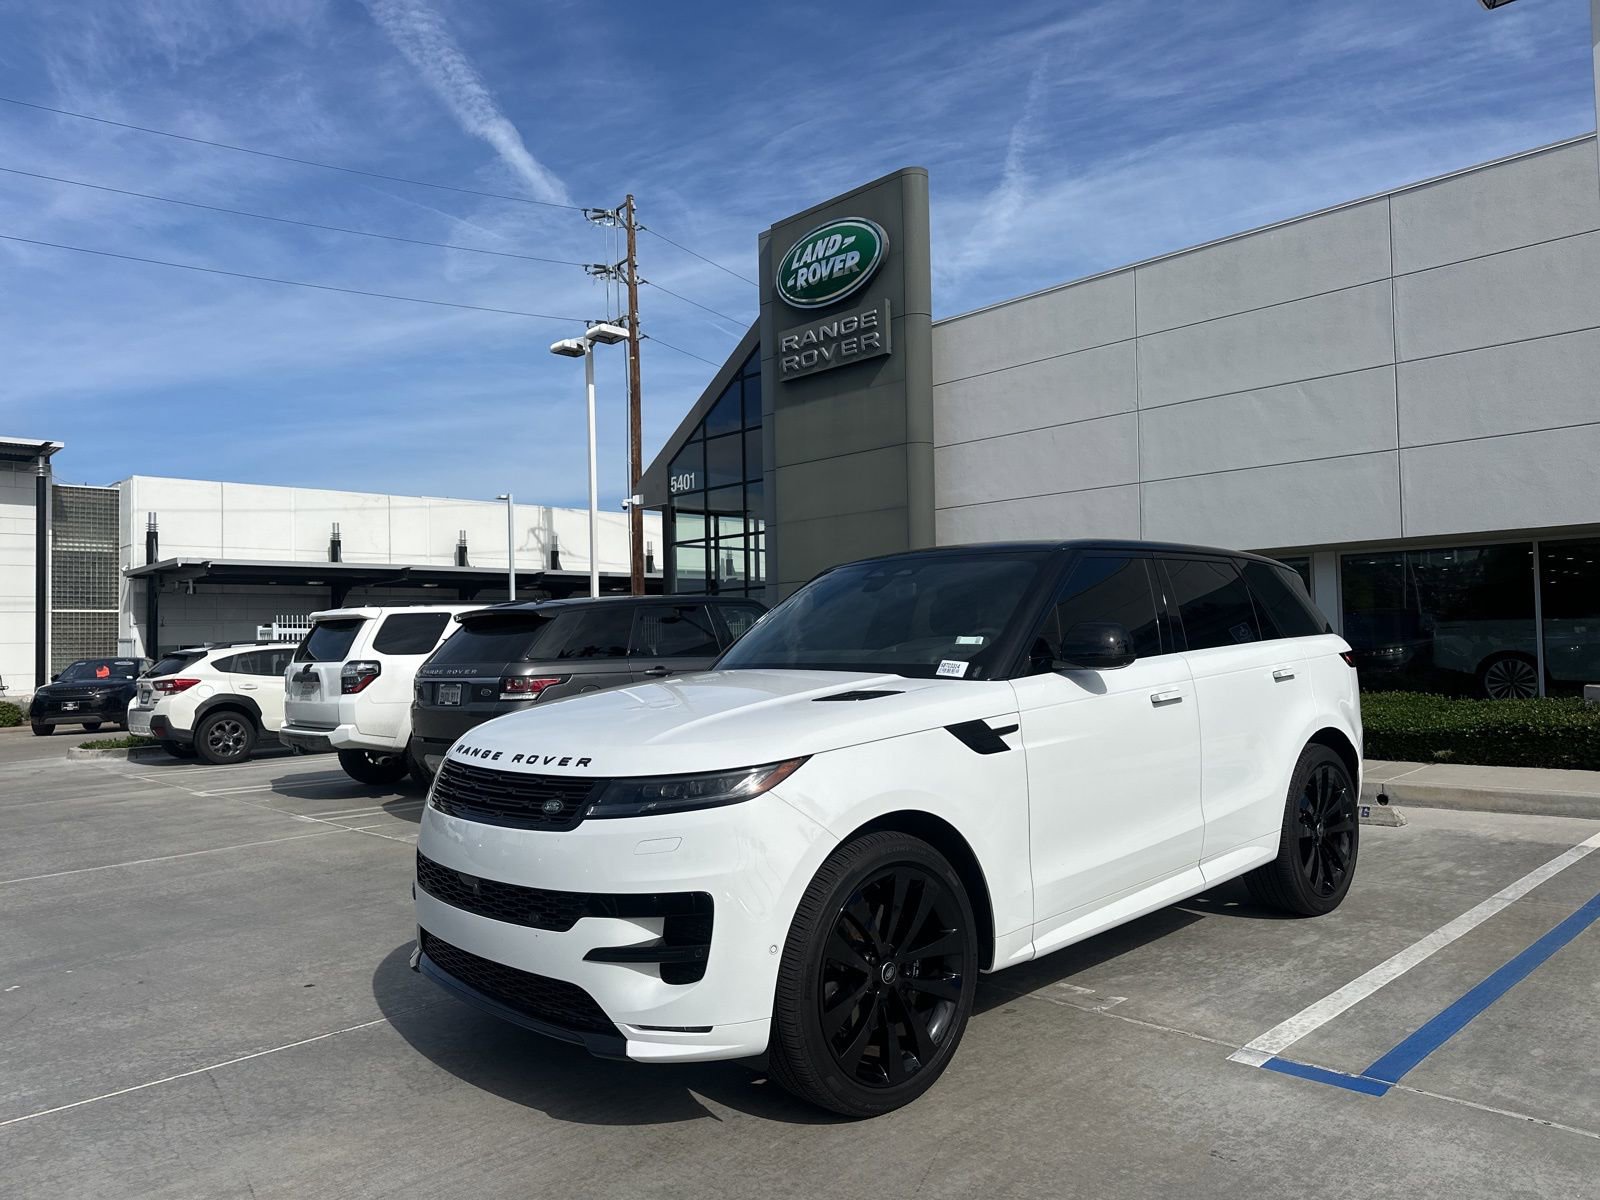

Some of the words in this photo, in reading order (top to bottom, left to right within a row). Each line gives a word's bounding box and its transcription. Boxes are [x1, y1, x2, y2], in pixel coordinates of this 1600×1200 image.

[791, 234, 842, 270] LAND
[796, 251, 861, 291] ROVER
[782, 309, 878, 352] RANGE
[782, 332, 880, 373] ROVER
[671, 472, 695, 492] 5401
[455, 744, 503, 760] RANGE
[511, 754, 592, 767] ROVER
